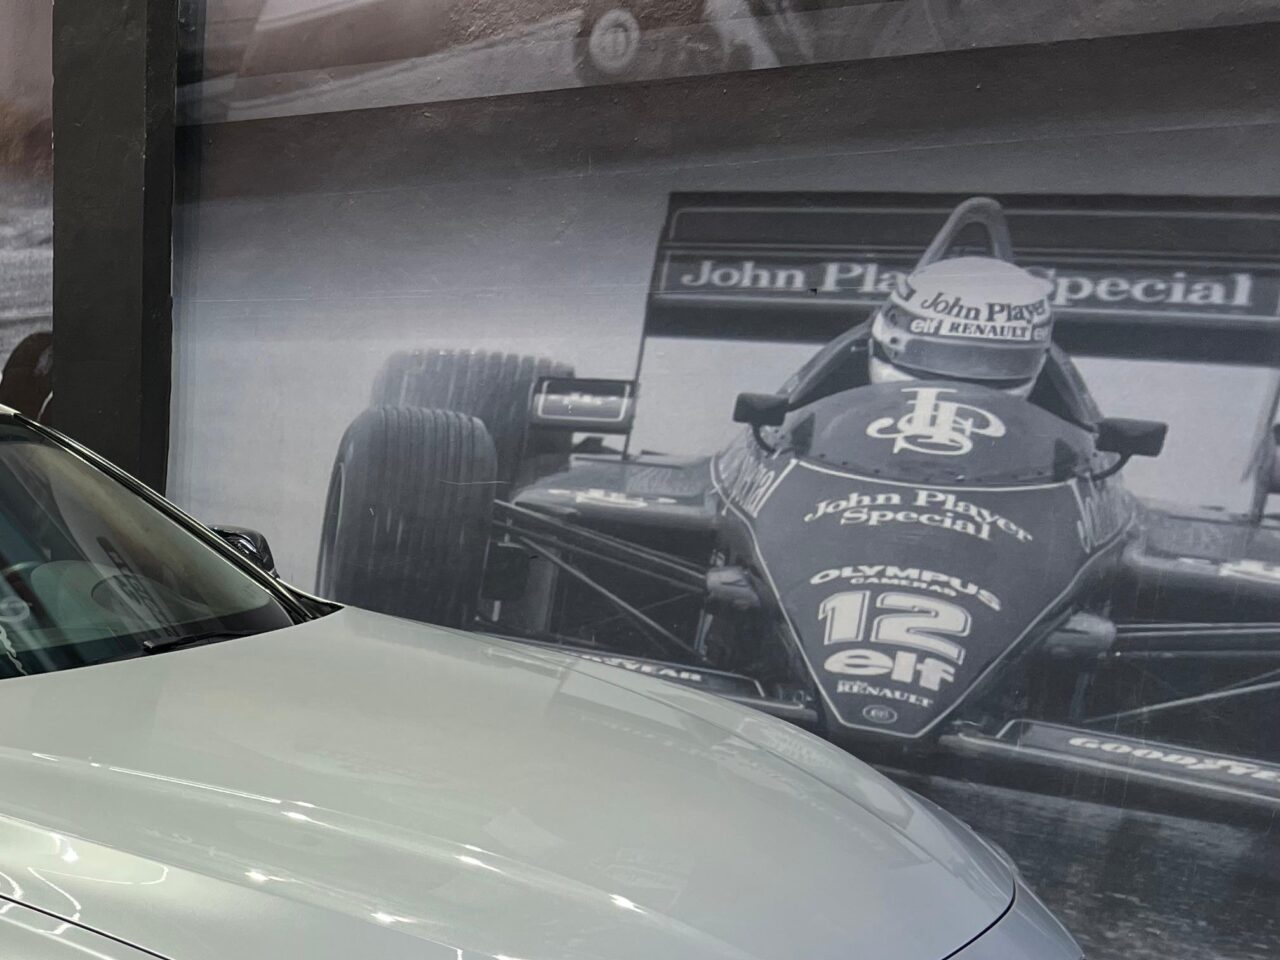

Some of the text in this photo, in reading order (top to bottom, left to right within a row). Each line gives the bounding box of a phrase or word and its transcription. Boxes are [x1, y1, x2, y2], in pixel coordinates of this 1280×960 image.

[681, 260, 1252, 307] John Pla pecial
[910, 318, 940, 334] elf
[948, 321, 1030, 338] RENAULT
[921, 292, 1045, 324] John Playe
[804, 492, 901, 522] John
[914, 489, 1033, 542] Player
[840, 507, 993, 541] Special
[810, 565, 1002, 612] OLYMPUS
[818, 590, 972, 666] 12
[823, 649, 956, 691] elf
[837, 682, 934, 707] RENAULT
